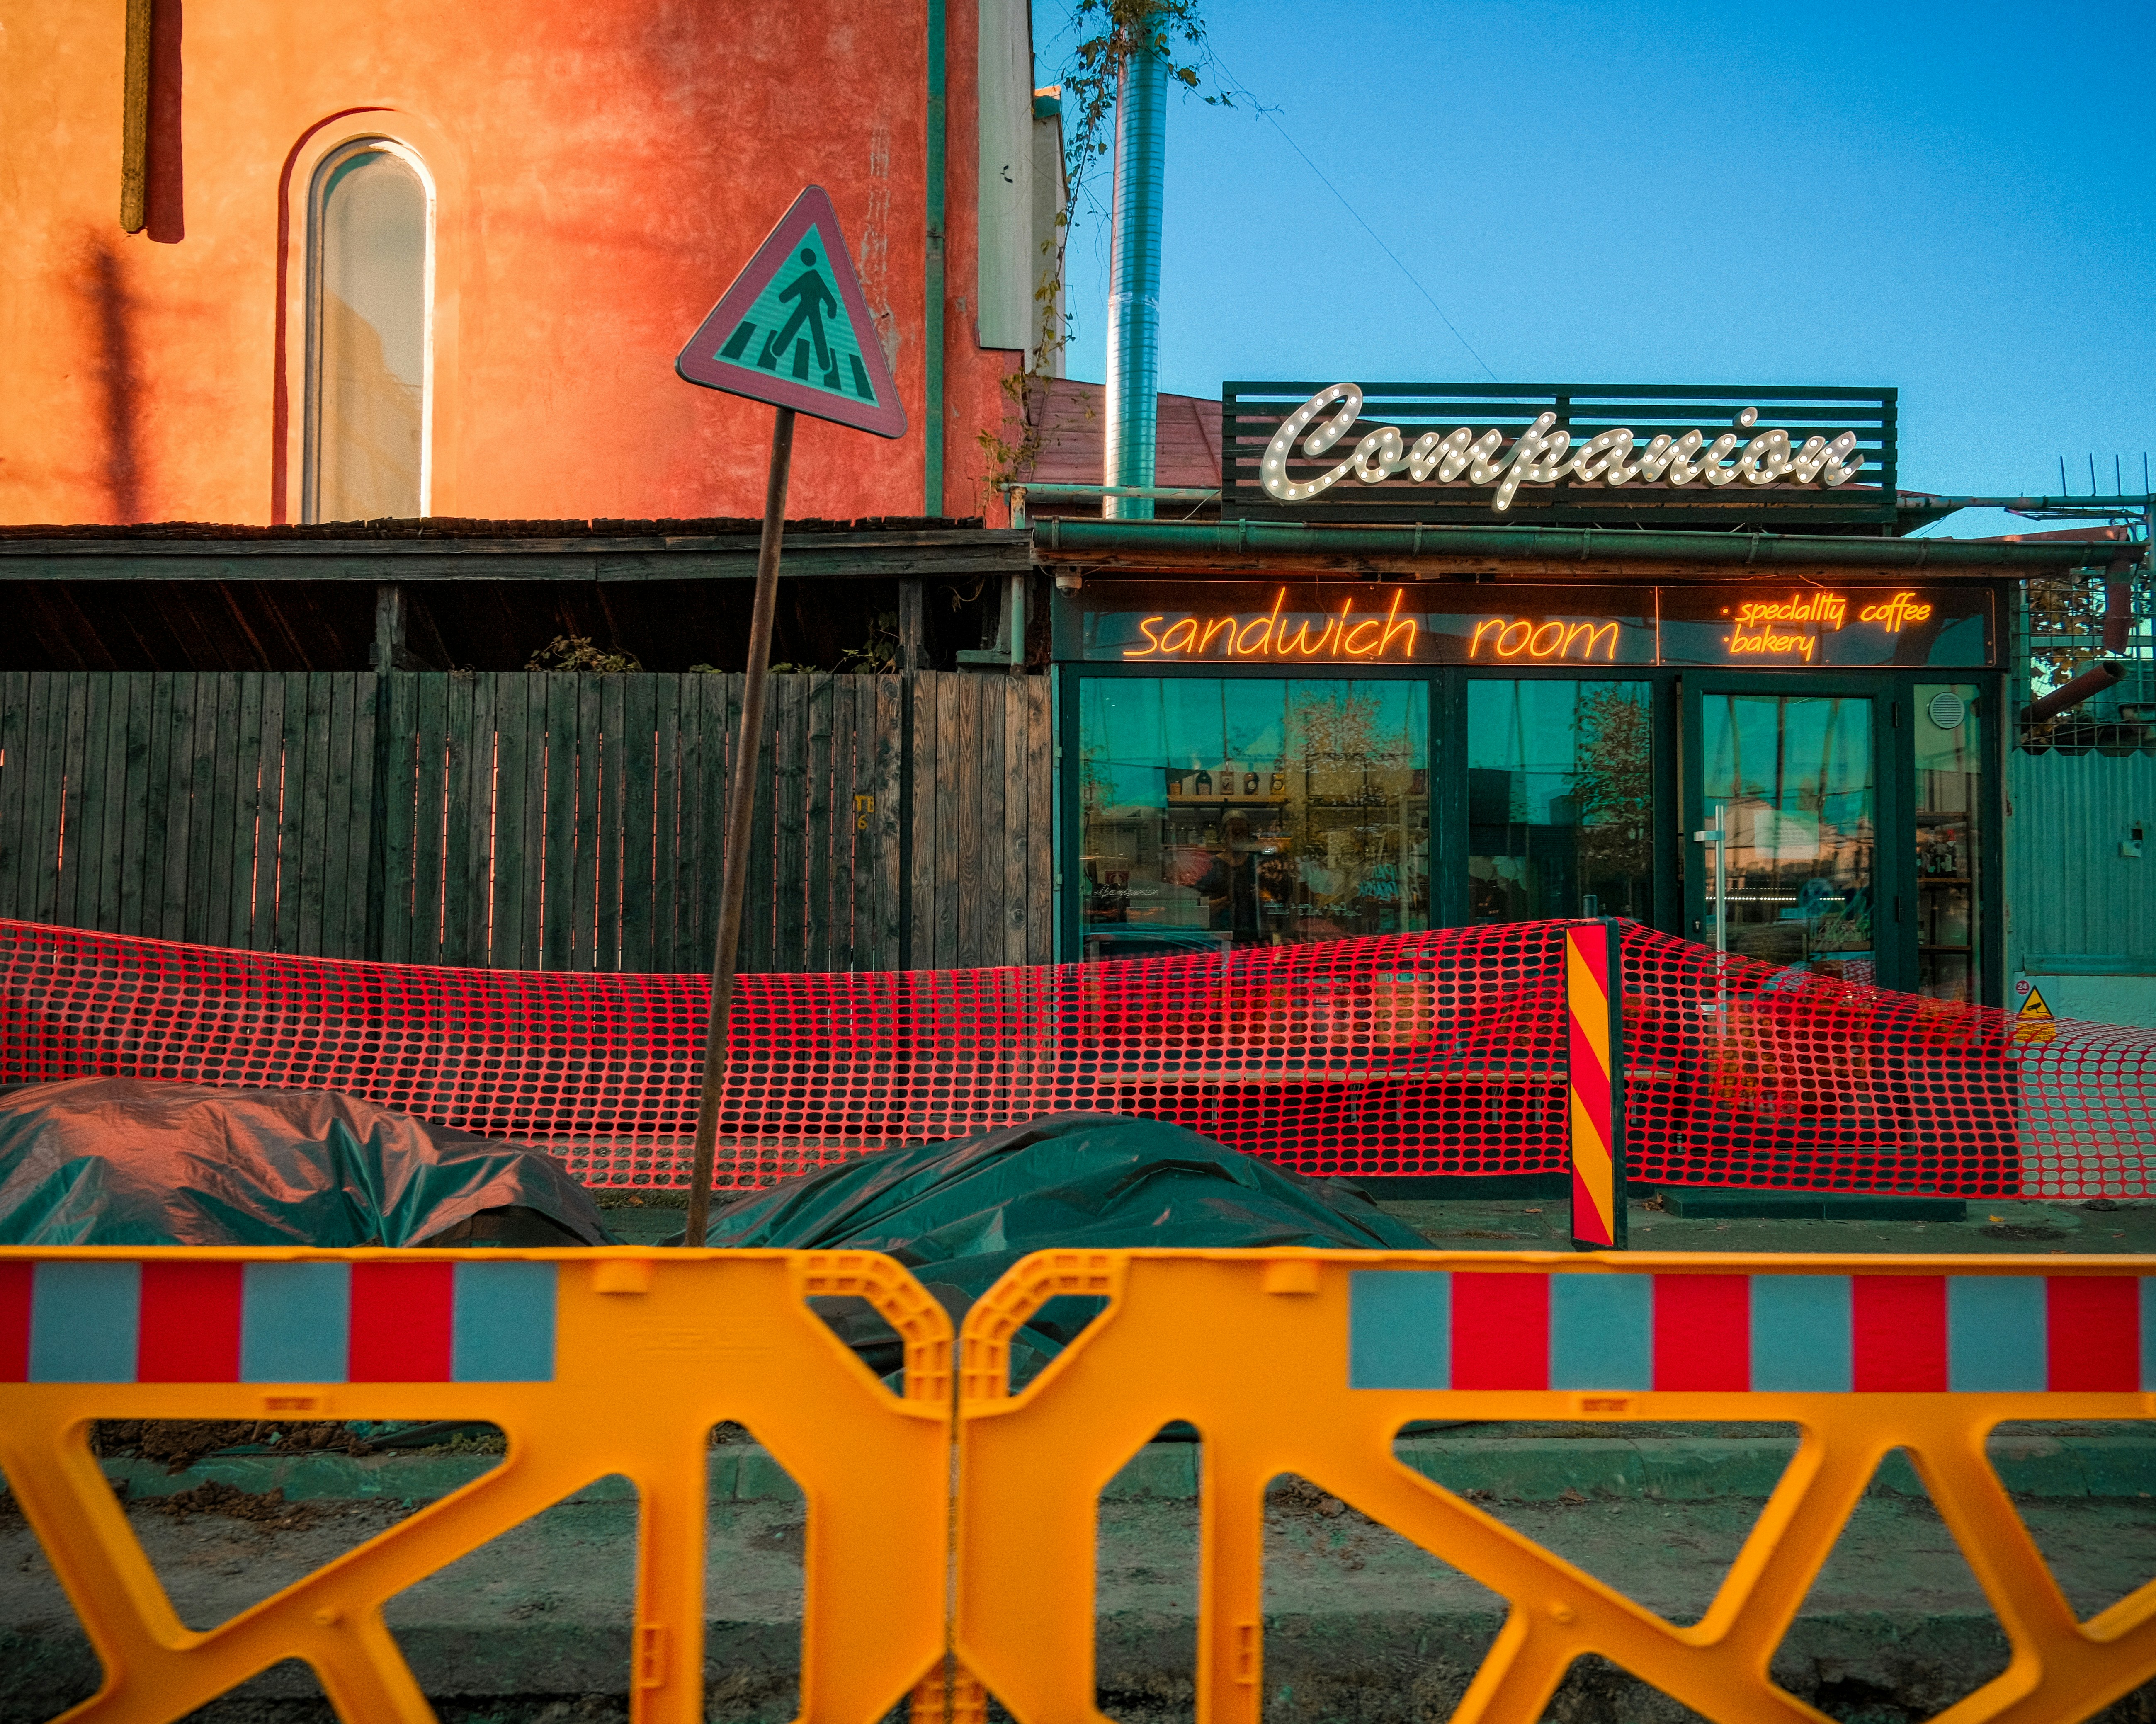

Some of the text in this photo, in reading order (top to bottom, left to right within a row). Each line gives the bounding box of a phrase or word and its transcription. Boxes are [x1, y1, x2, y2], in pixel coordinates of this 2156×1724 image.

[1260, 383, 1864, 512] Companion
[1123, 587, 1619, 660] sandwich room
[1860, 592, 1931, 632] coffee
[1730, 623, 1816, 661] bakery
[858, 814, 868, 830] 6
